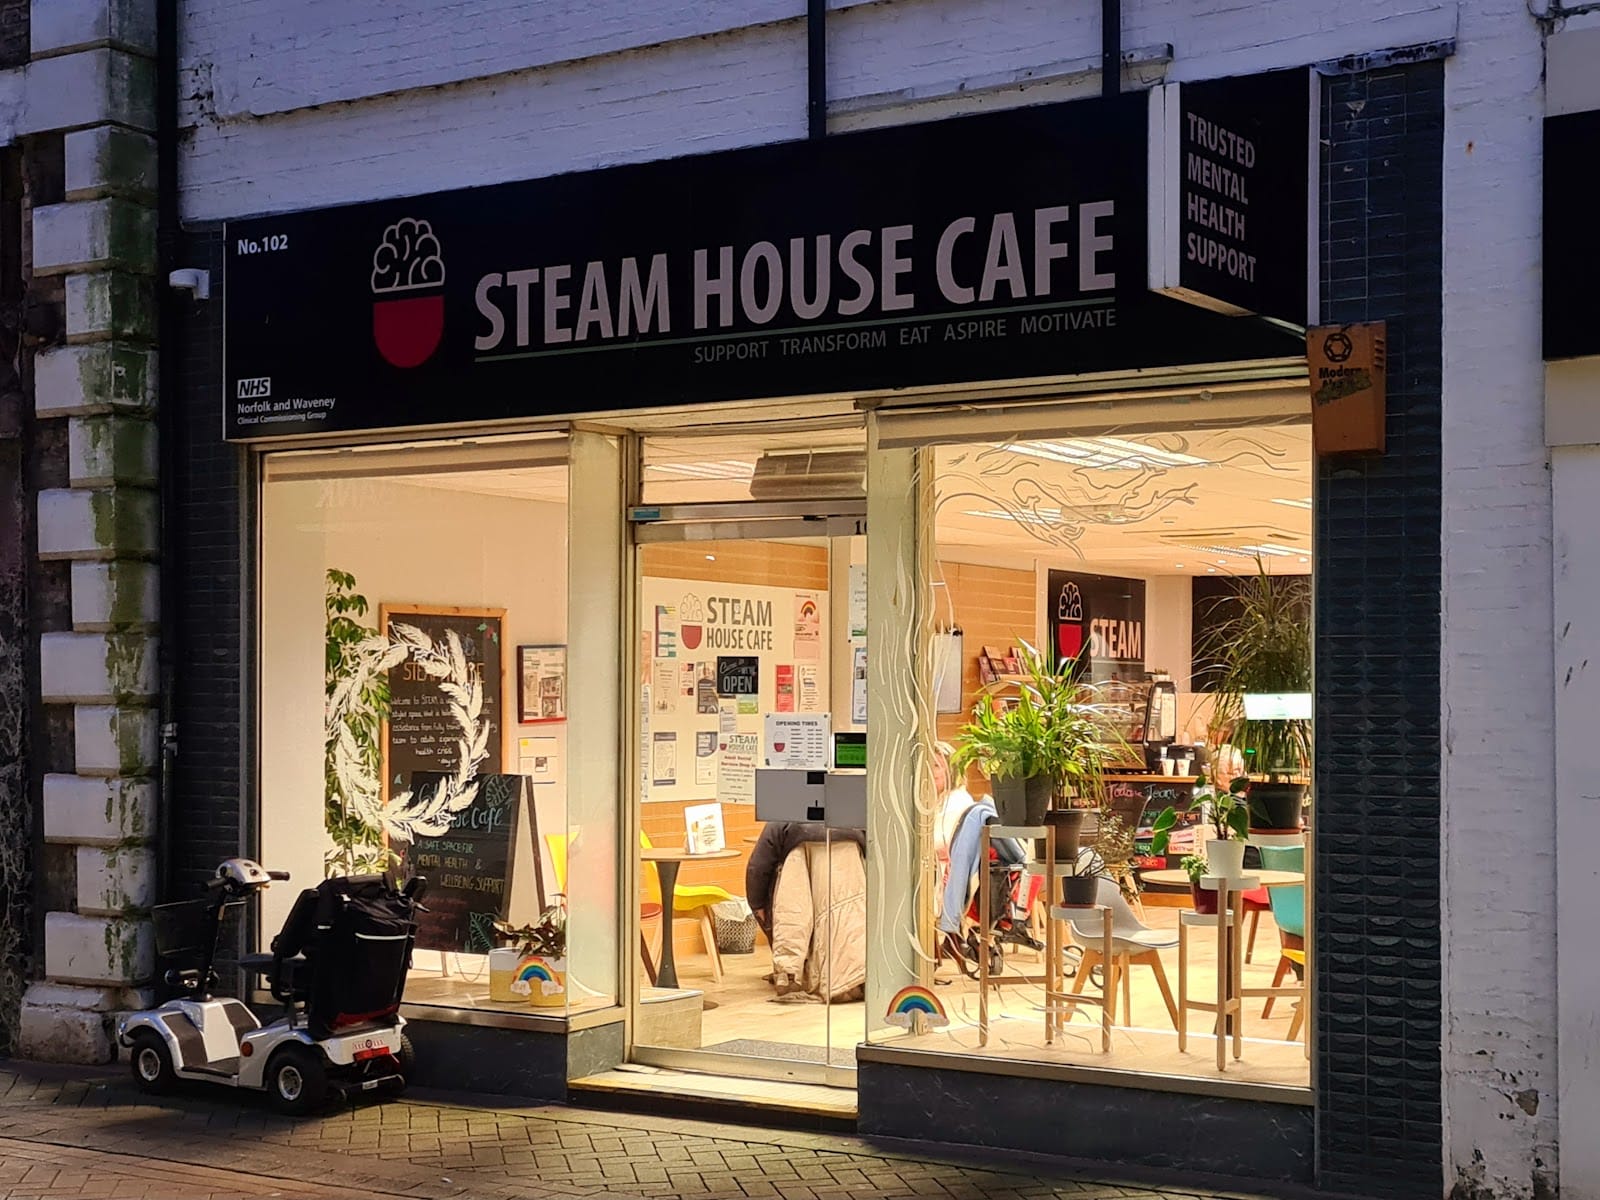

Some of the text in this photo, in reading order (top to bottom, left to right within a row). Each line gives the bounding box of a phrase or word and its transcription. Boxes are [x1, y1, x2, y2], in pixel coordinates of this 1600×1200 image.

[1187, 112, 1256, 169] TRUSTED
[1187, 152, 1249, 205] MENTAL
[1187, 191, 1245, 241] HEALTH
[237, 234, 289, 255] No.102
[1187, 232, 1257, 283] SUPPORT
[474, 200, 1116, 351] STEAM HOUSE CAFE
[694, 309, 1117, 363] SUPPORT TRANSFORM EAT ASPIRE MOTIVATE
[237, 398, 336, 414] Norfolk and Waveney
[238, 378, 270, 398] NHS
[706, 596, 773, 627] STEAM
[706, 628, 745, 650] HOUSE
[746, 632, 773, 650] CAFE
[1089, 618, 1142, 660] STEAM
[723, 675, 753, 693] OPEN
[729, 734, 758, 745] STEAM
